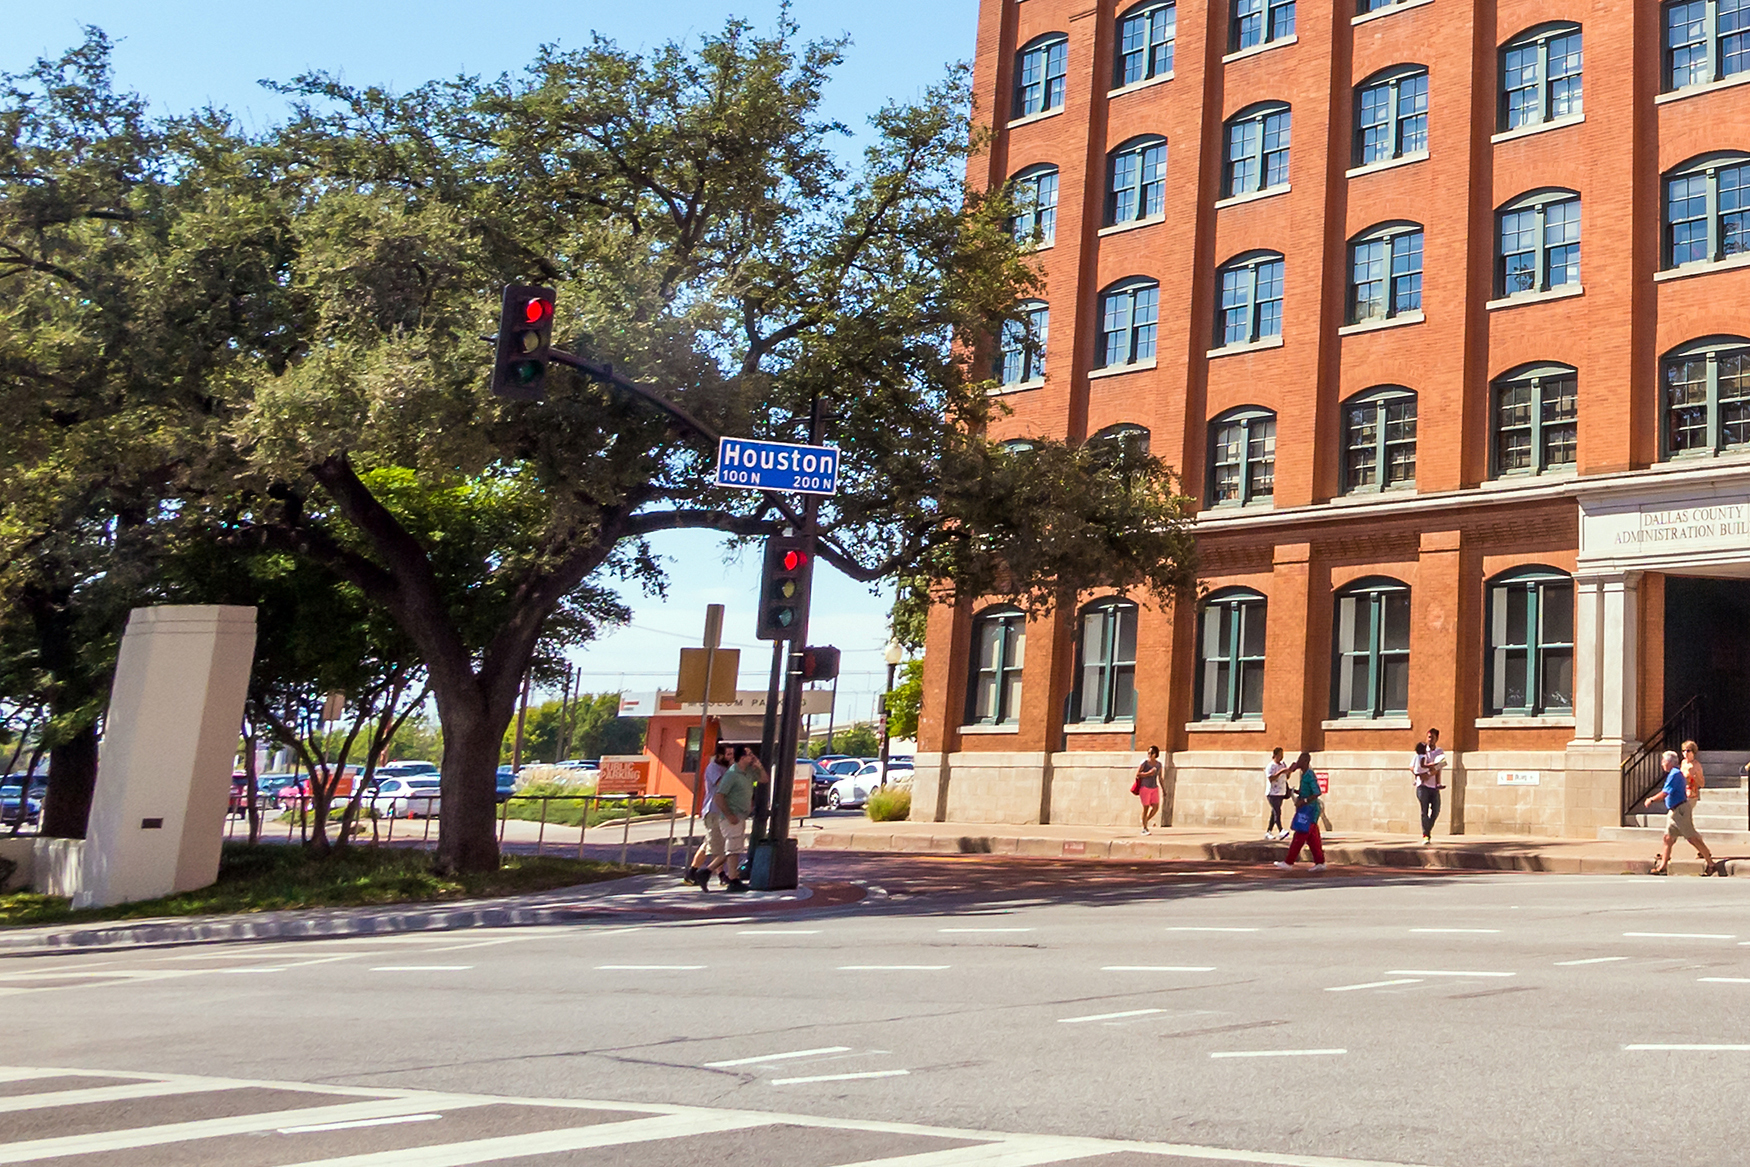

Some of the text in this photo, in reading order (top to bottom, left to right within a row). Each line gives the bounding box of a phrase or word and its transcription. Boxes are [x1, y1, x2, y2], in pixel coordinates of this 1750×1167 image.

[724, 443, 833, 474] Houston
[723, 469, 832, 490] 100 N 200 N
[1644, 506, 1744, 526] DALLAS COUNTY
[1614, 523, 1715, 544] ADMINISTRATION
